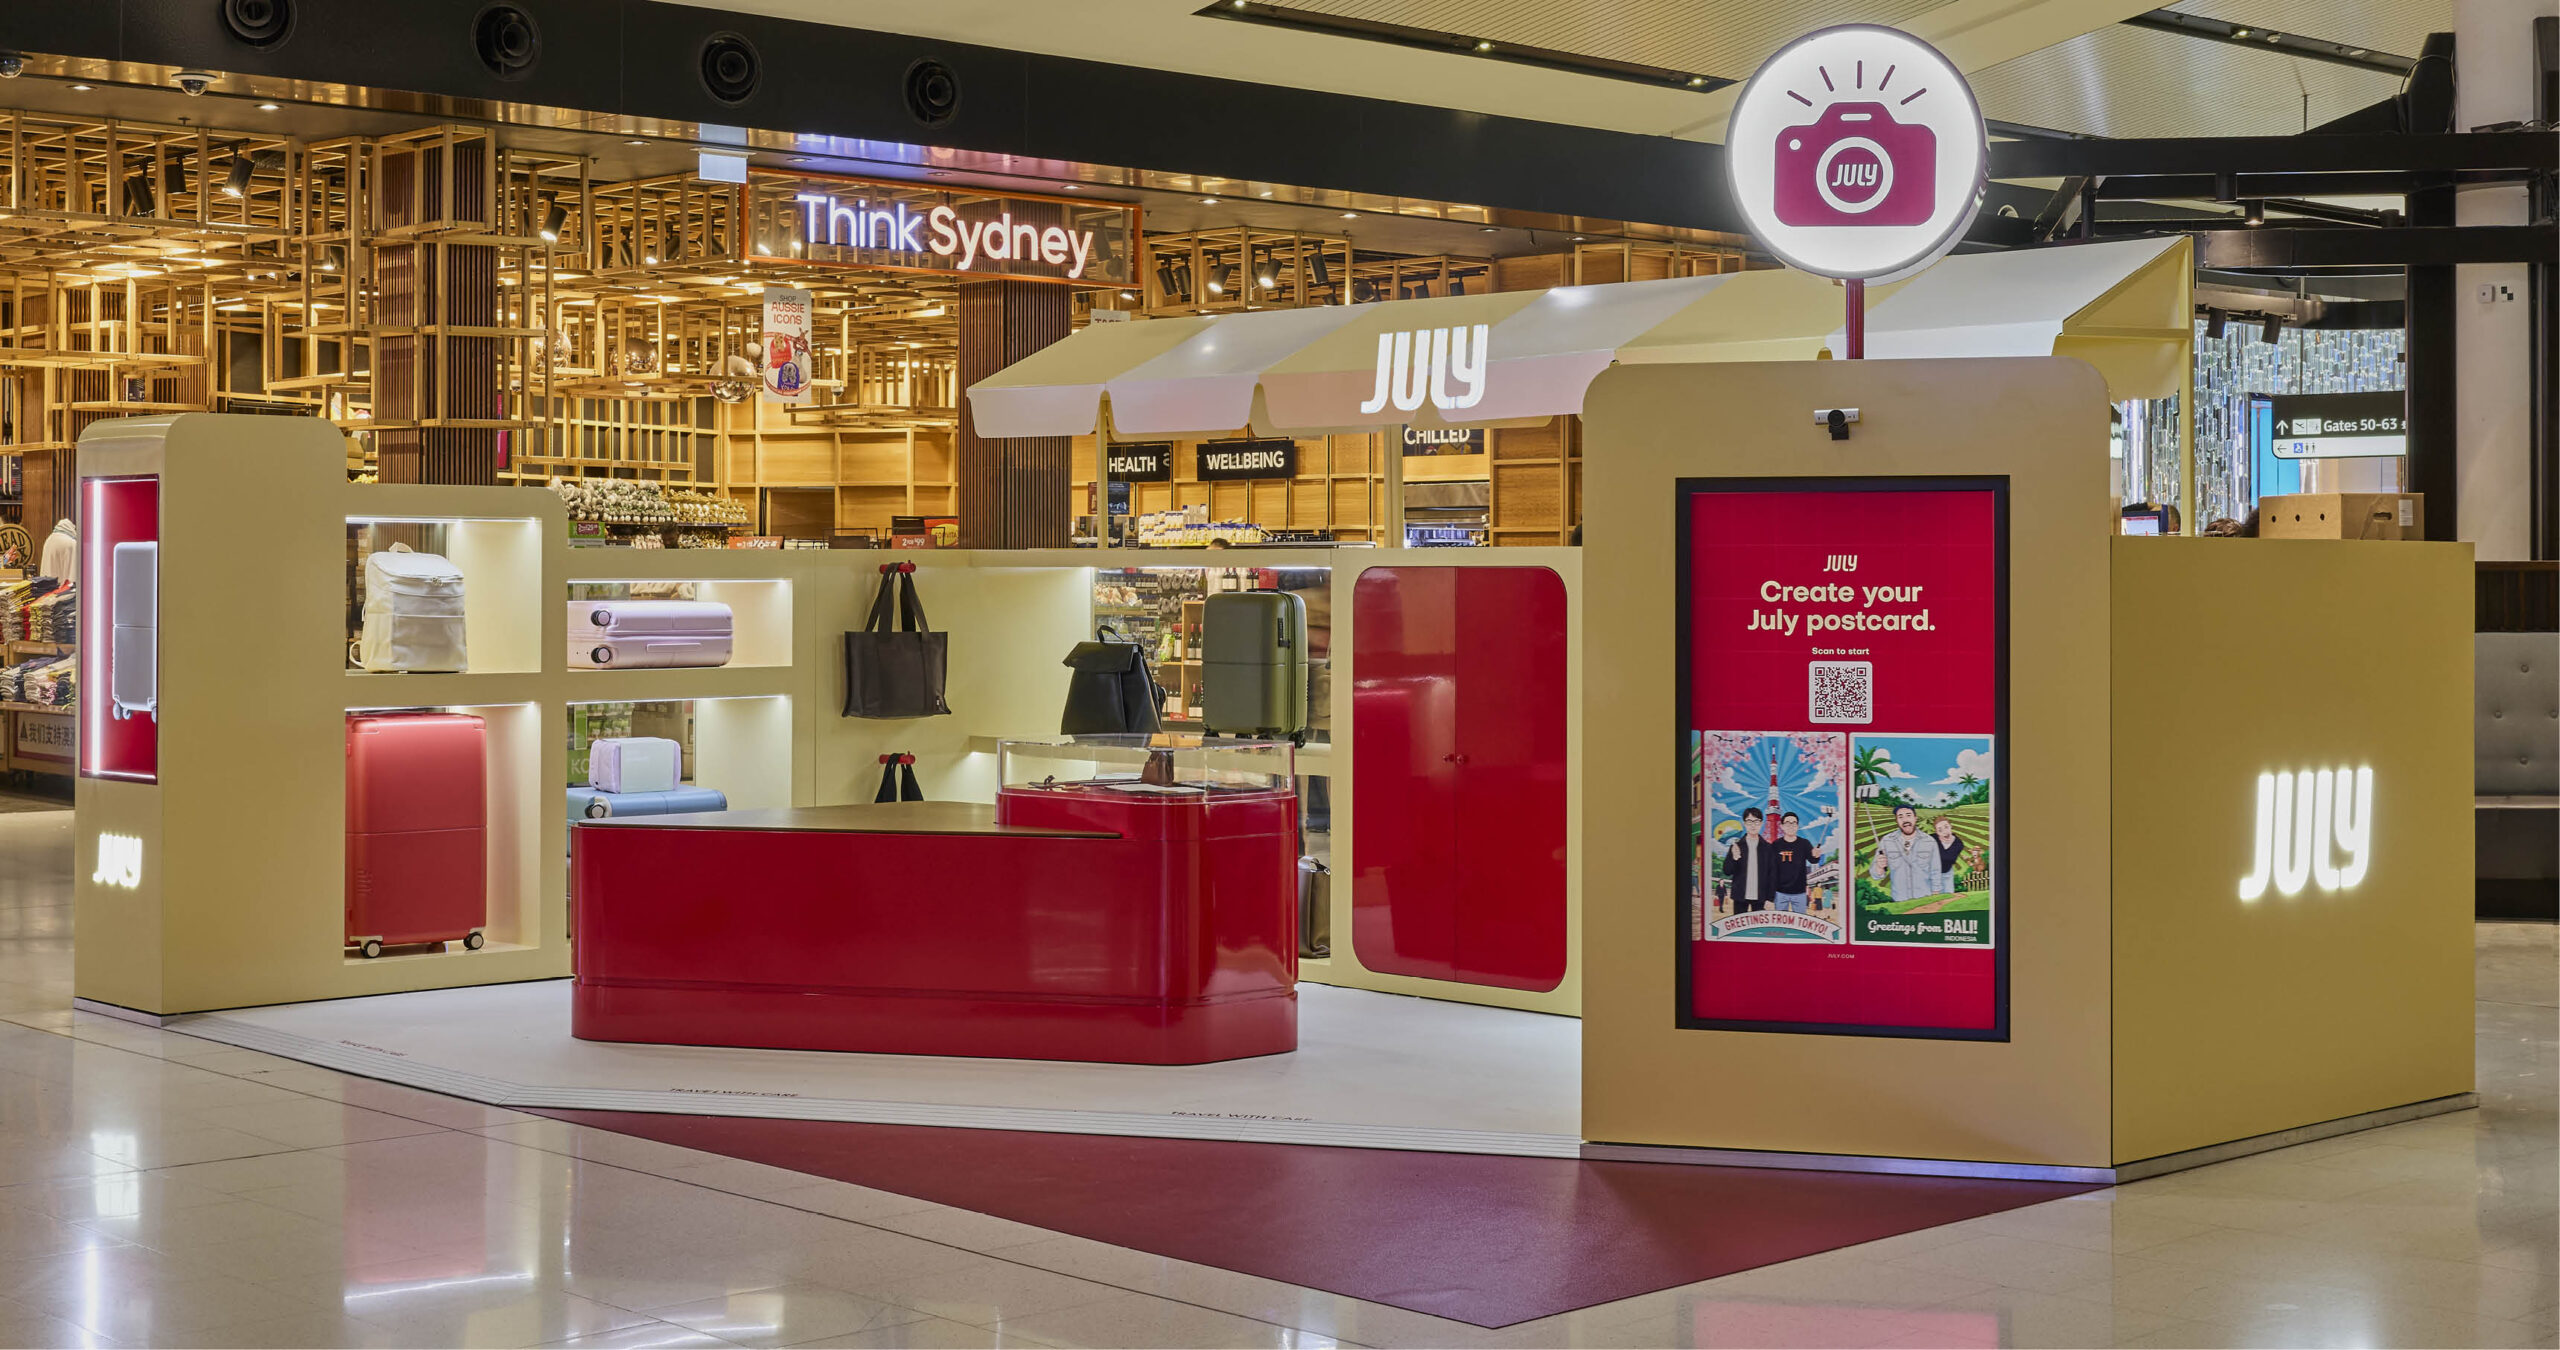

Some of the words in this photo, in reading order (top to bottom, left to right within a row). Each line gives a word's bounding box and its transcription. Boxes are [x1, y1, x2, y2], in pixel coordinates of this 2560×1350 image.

[1832, 164, 1878, 187] JULY
[796, 194, 923, 252] Think
[929, 205, 1094, 279] Sydney
[771, 301, 805, 314] AUSSIE
[1360, 324, 1489, 414] JULY
[2323, 420, 2358, 432] Gates
[2360, 418, 2398, 431] 50-63
[1404, 427, 1470, 445] CHILLED
[1109, 456, 1157, 473] HEALTH
[1206, 450, 1285, 471] WELLBEING
[1823, 554, 1858, 572] JULY
[1760, 580, 1855, 602] Create
[1862, 585, 1923, 608] your
[1747, 608, 1799, 636] July
[1807, 608, 1936, 636] postcard.
[1811, 647, 1834, 655] Scan
[1836, 647, 1846, 655] to
[1848, 647, 1870, 655] start
[2239, 767, 2373, 901] JULY
[1724, 913, 1770, 931] GREETINGS
[1771, 913, 1795, 925] FROM
[1798, 916, 1829, 936] TOKYO!
[1867, 919, 1916, 935] Greetings
[1917, 921, 1943, 935] from
[1943, 918, 1978, 934] BALI!
